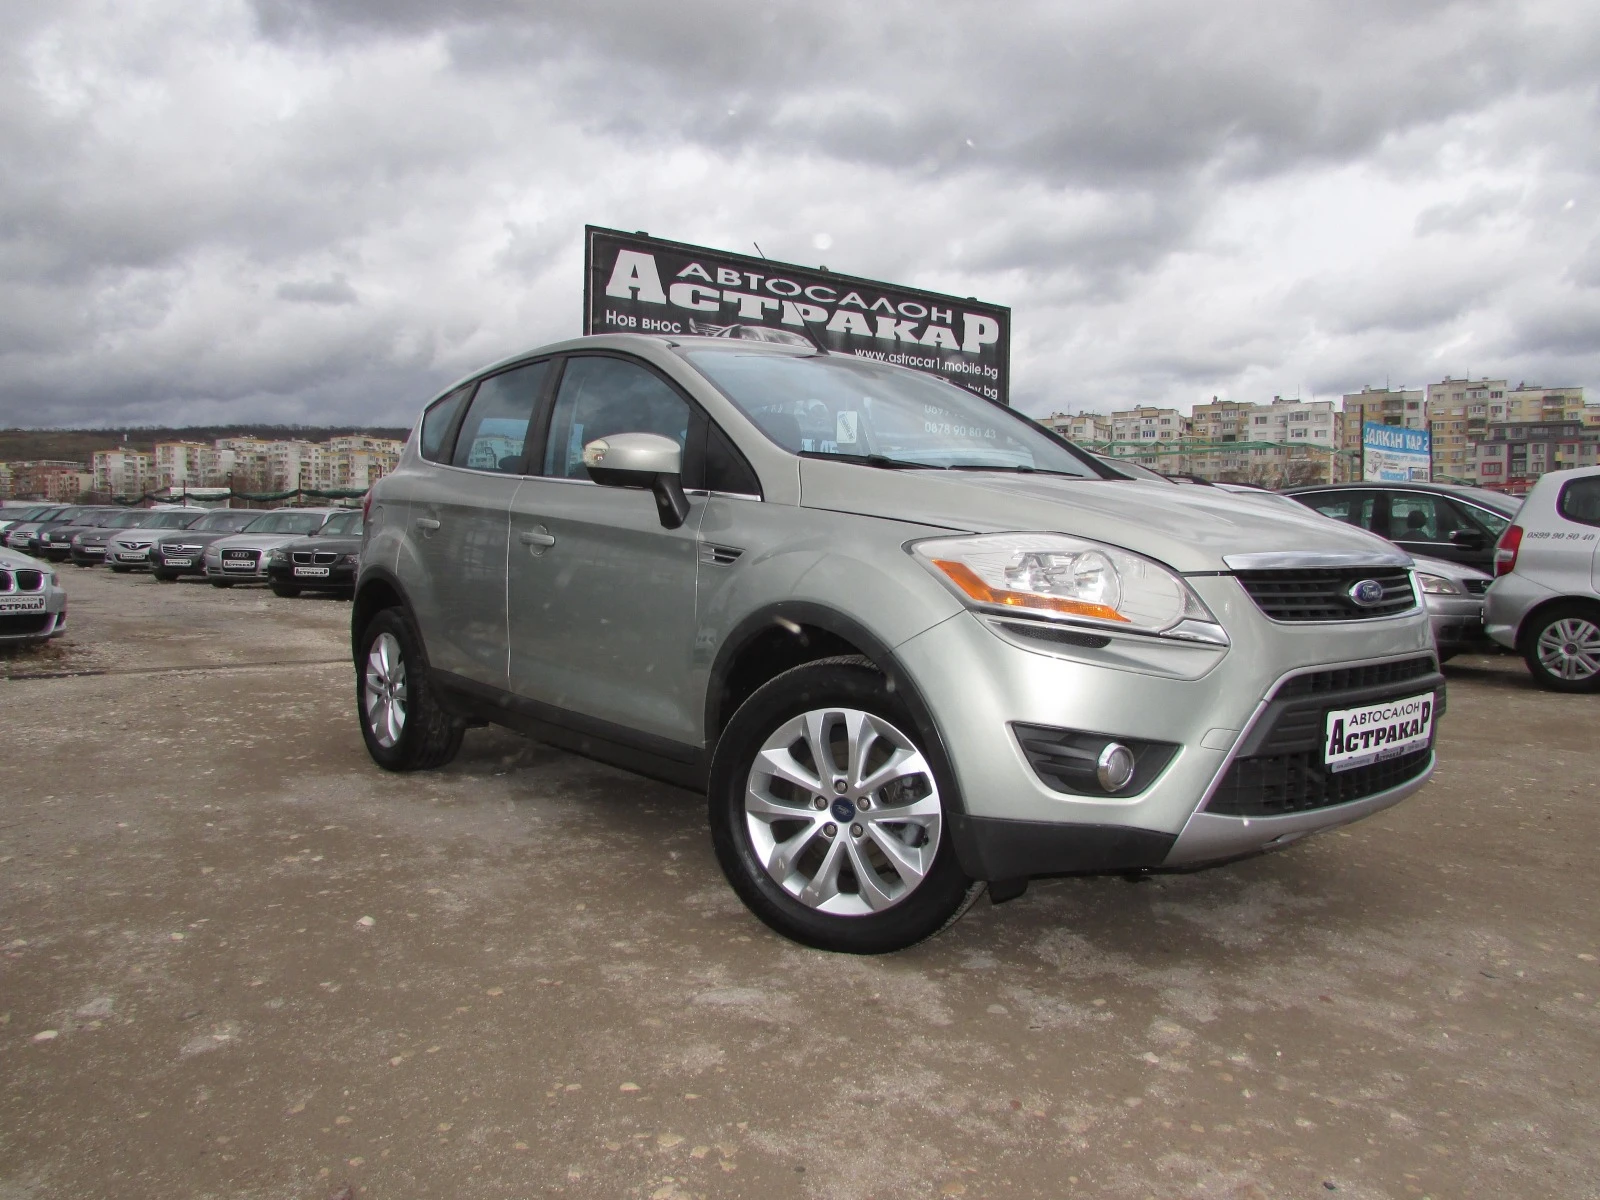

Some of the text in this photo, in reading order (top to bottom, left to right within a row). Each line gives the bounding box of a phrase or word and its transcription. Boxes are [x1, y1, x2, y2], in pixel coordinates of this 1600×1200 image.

[676, 263, 953, 324] АВТОСАЛОН
[855, 348, 999, 379] www.astracar1.mobile.bg
[953, 425, 966, 436] 90
[0, 598, 44, 610] СТРАКАР
[1349, 702, 1420, 727] АВТОСАЛОН
